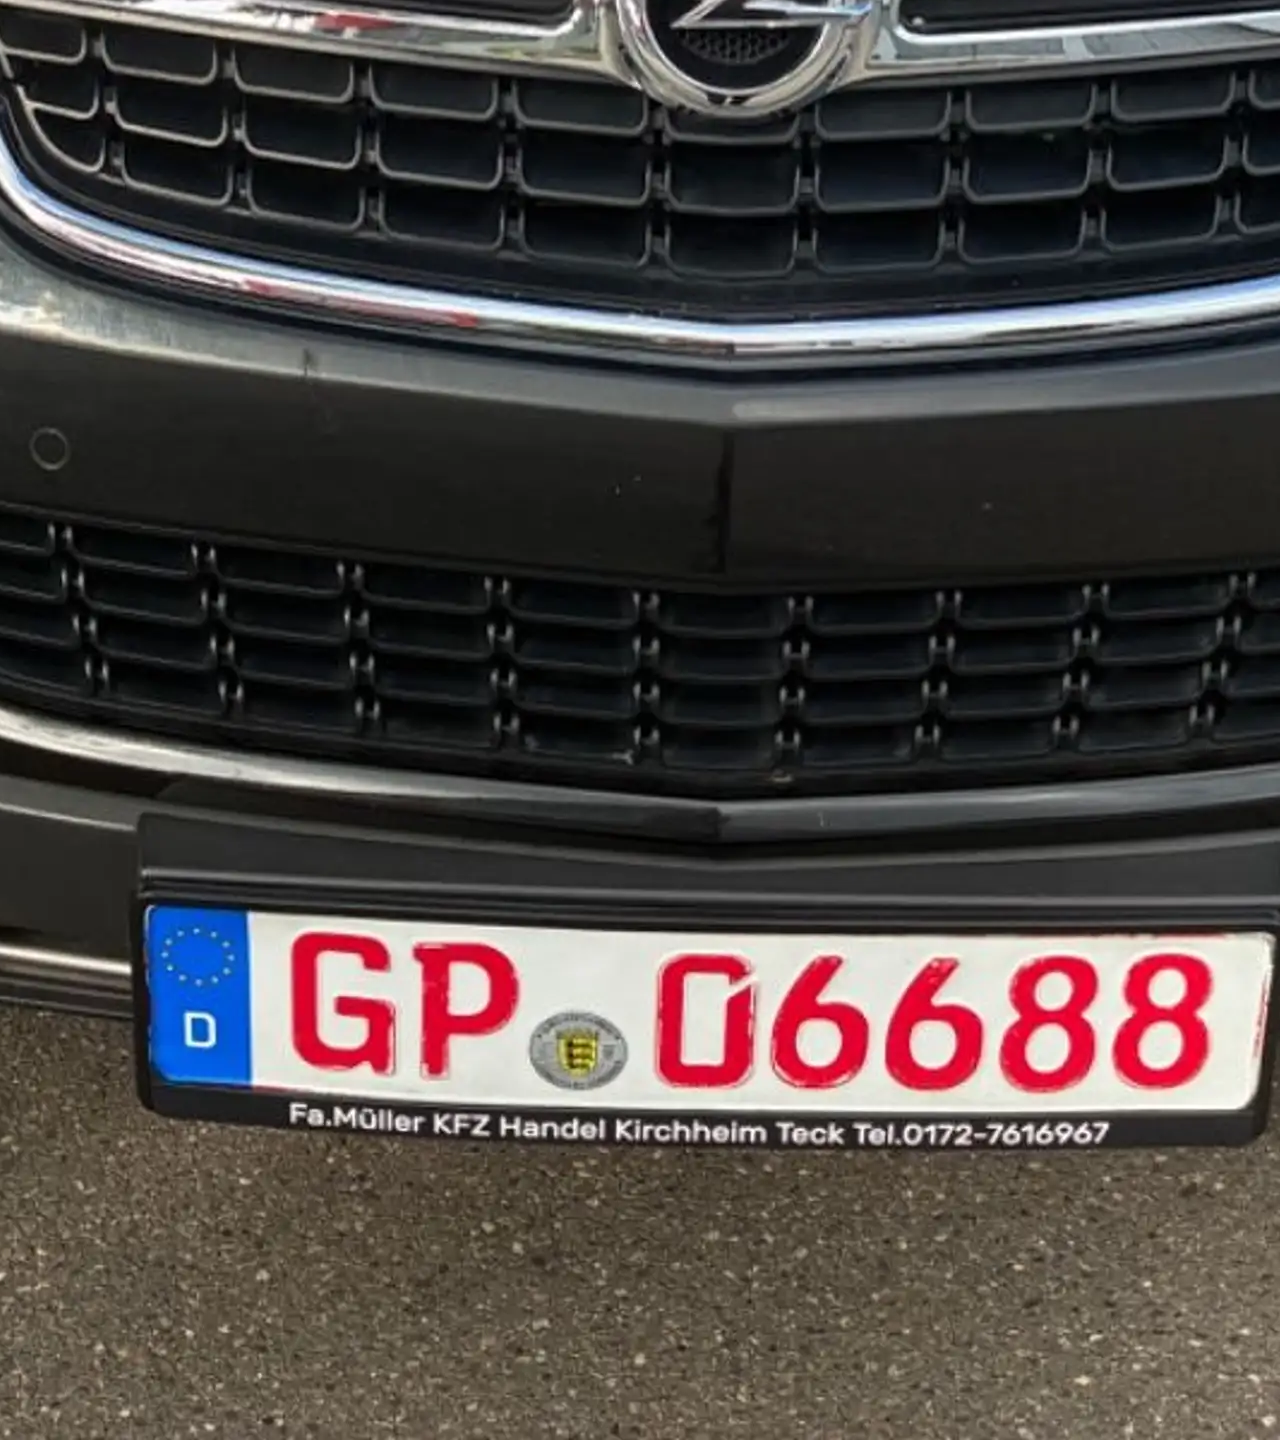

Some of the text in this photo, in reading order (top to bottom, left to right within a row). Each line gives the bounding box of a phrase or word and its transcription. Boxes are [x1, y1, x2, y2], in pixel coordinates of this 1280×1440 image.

[184, 1011, 217, 1049] D
[290, 930, 520, 1080] GP
[654, 952, 1214, 1094] 06688
[288, 1102, 1111, 1147] Fa.Müller KFZ Handel Kirchheim Teck Tel.0172-7616967
